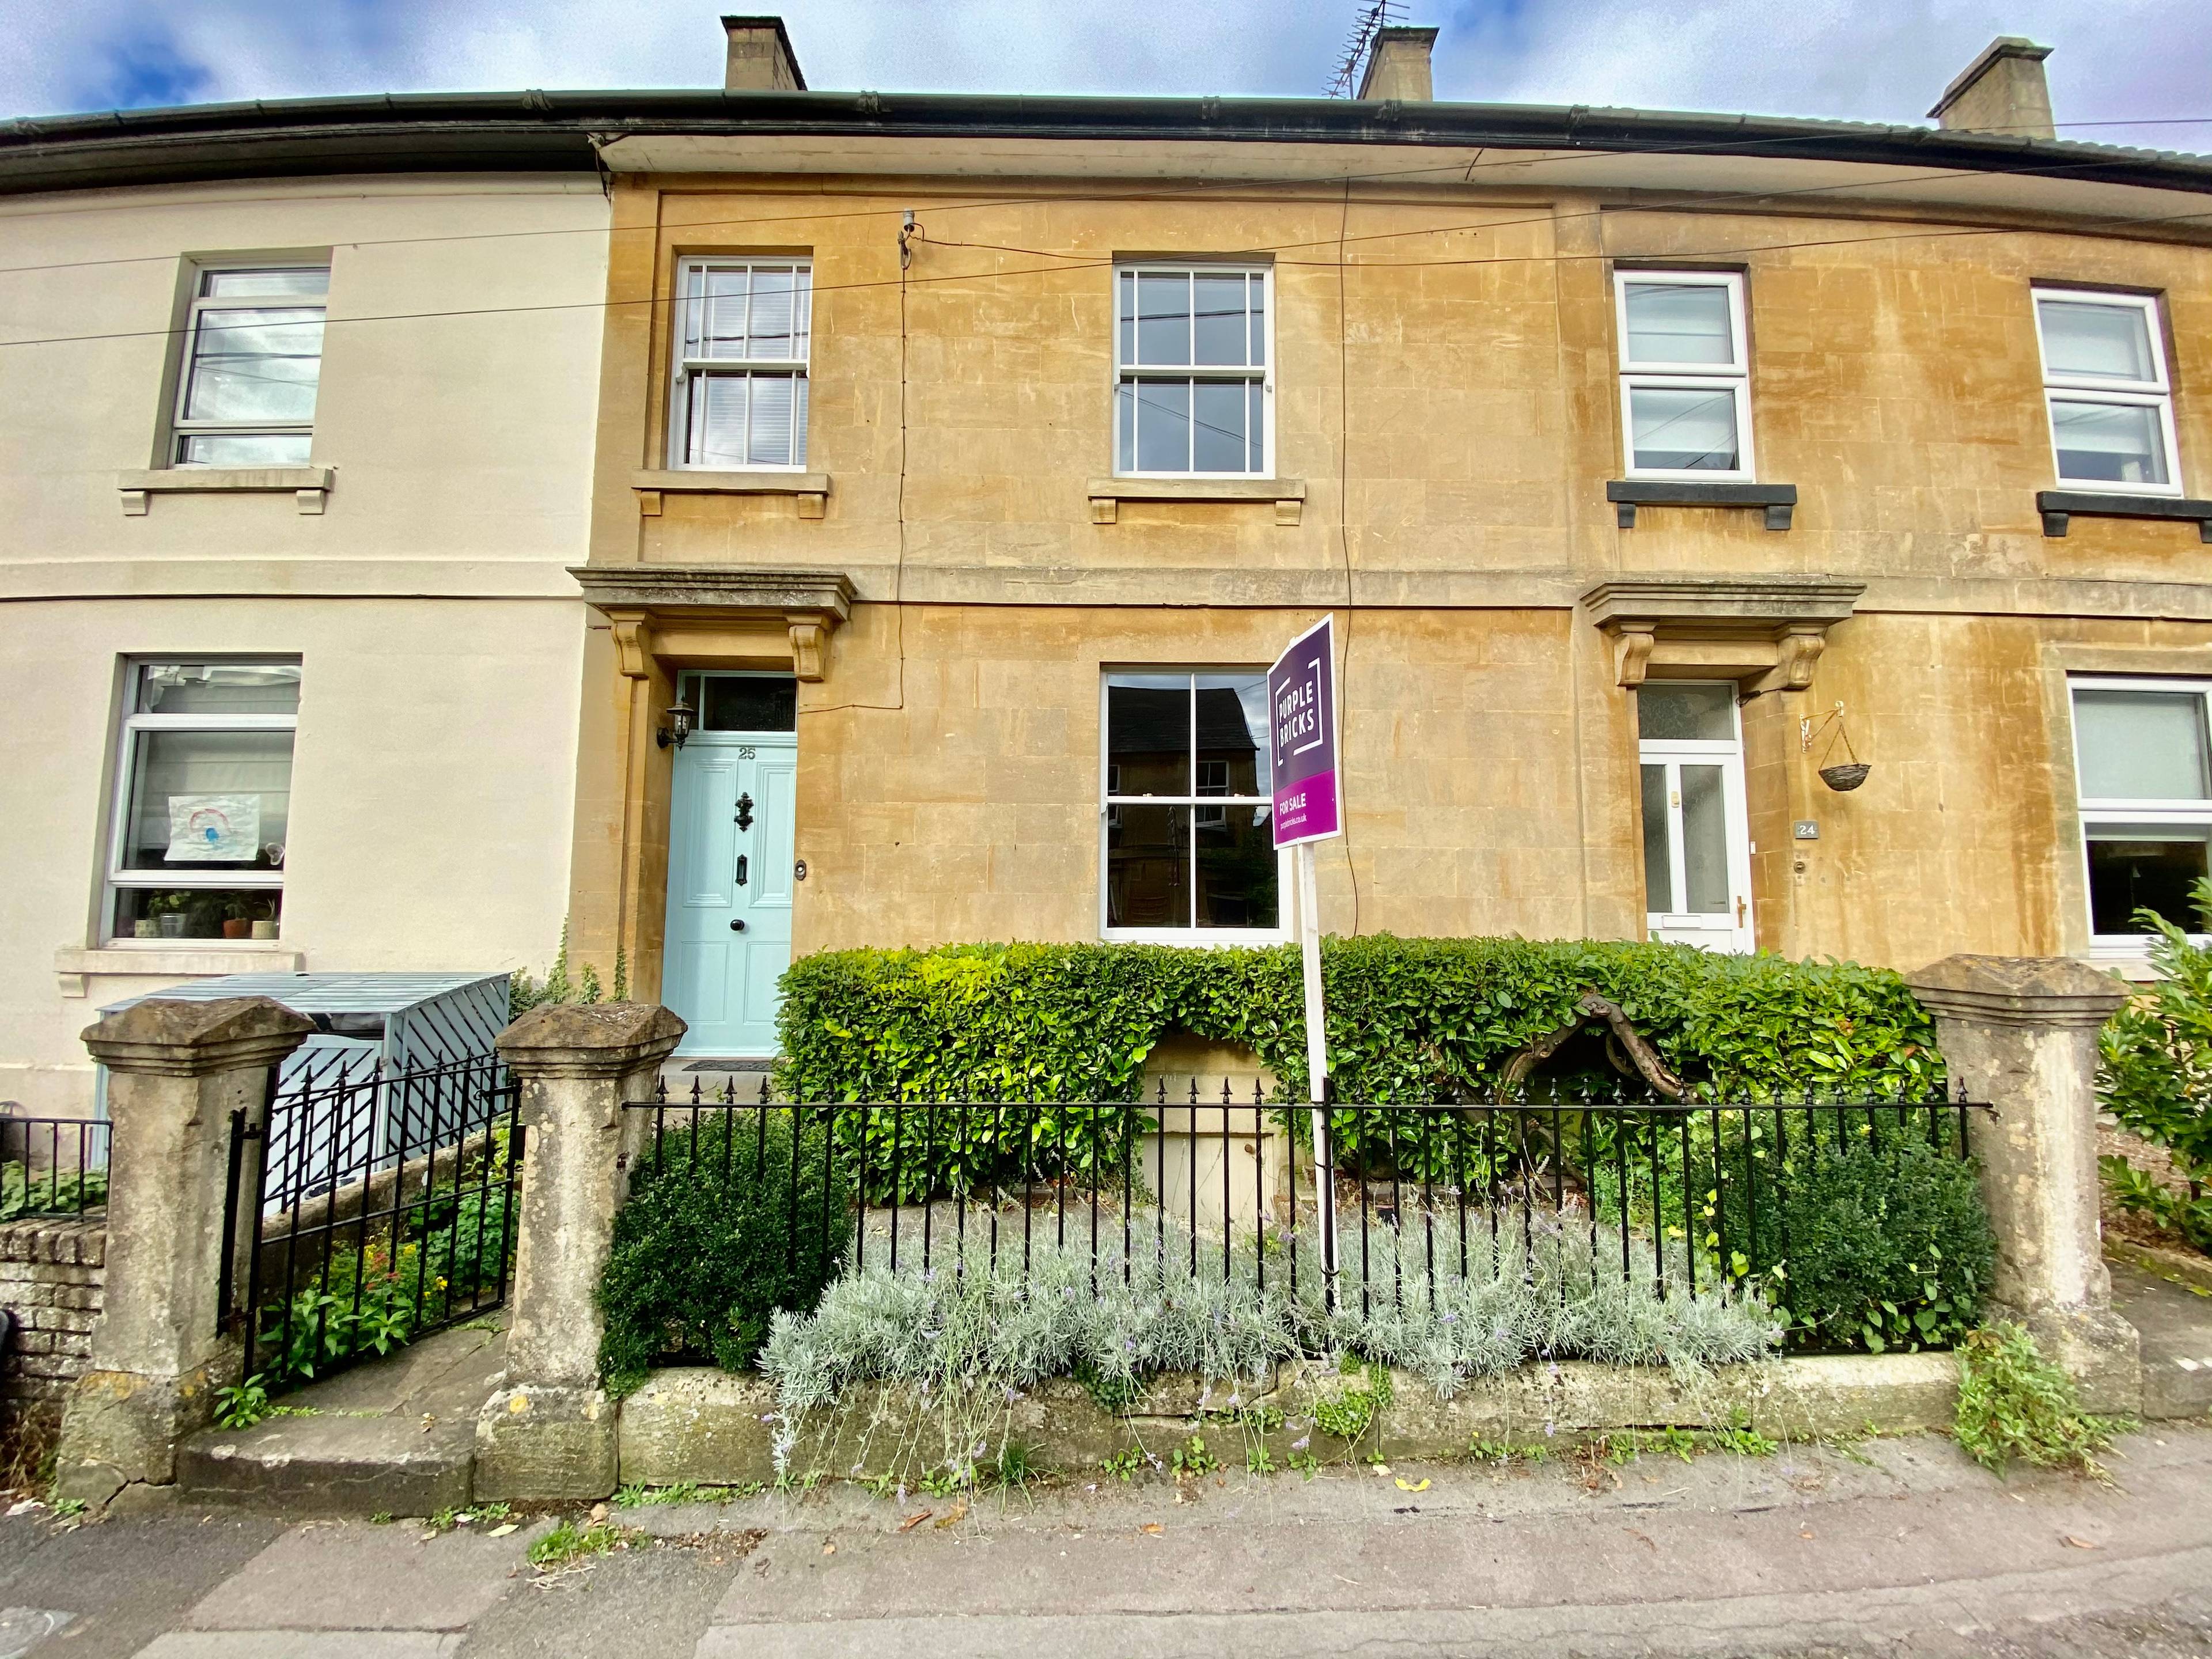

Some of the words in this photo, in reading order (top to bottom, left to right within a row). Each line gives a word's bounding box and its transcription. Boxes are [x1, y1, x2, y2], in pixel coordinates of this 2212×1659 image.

[1279, 680, 1313, 724] PURPLE
[1279, 708, 1314, 748] BRICKS
[738, 747, 756, 760] 25
[1279, 800, 1289, 816] FOR
[1289, 792, 1306, 812] SALE
[1800, 824, 1816, 835] 24
